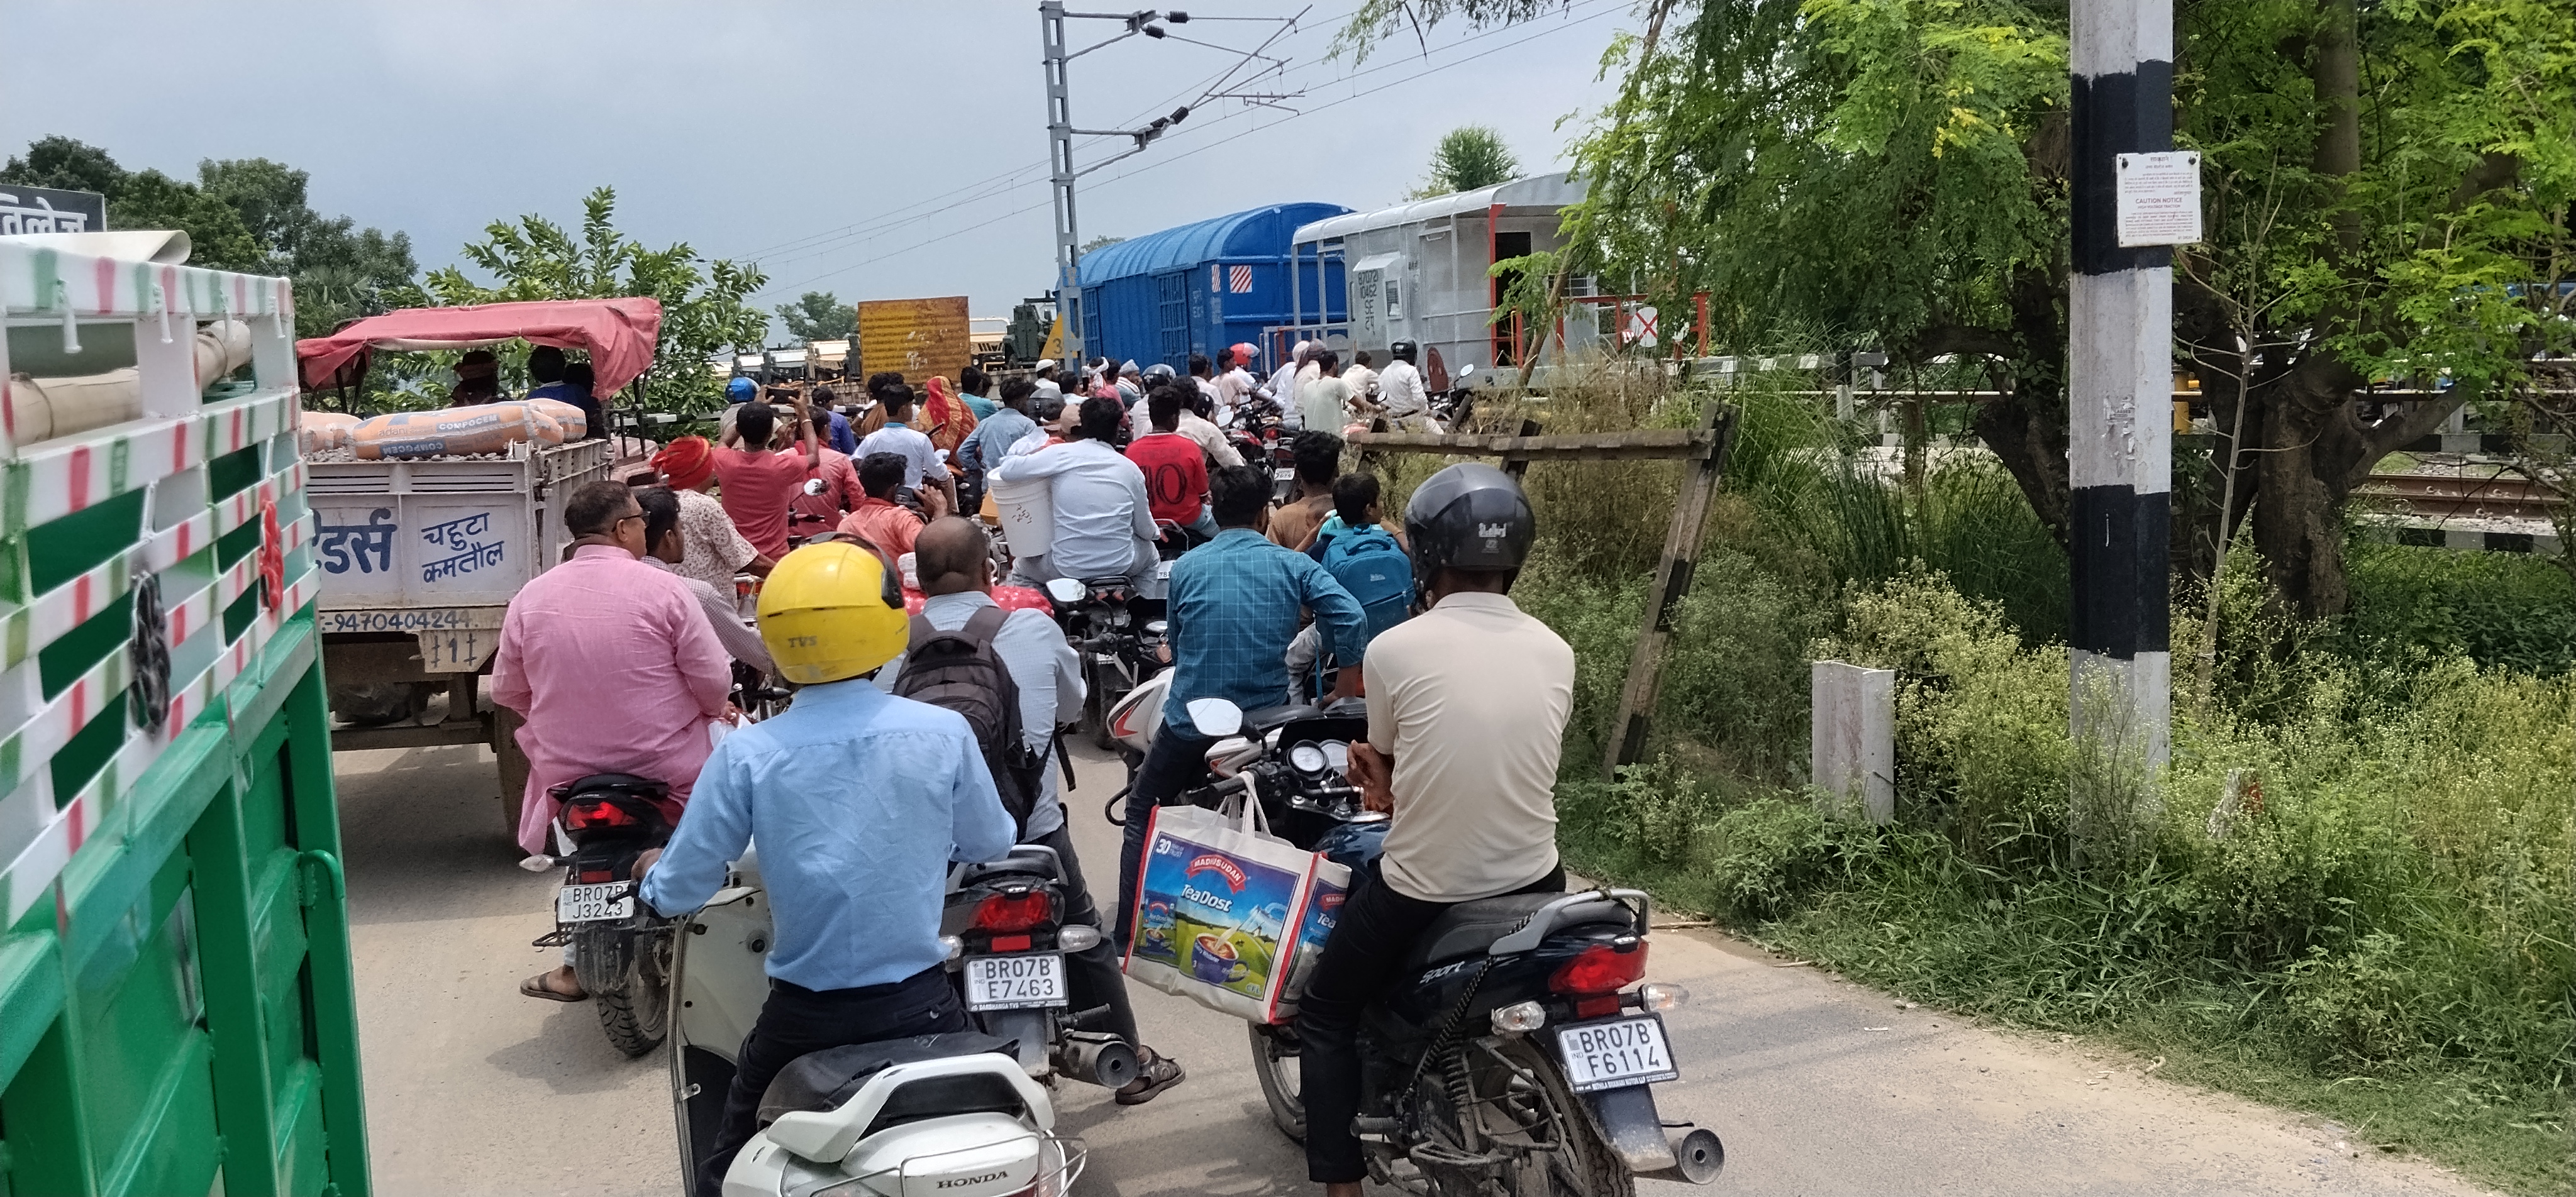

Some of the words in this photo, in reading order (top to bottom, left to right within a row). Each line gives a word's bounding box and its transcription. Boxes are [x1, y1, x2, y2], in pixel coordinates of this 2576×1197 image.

[1053, 338, 1063, 354] 3
[439, 414, 498, 430] COMPOCEM
[1140, 463, 1188, 507] 10
[313, 507, 398, 573] डर्स
[421, 512, 490, 551] चहुटा
[421, 541, 505, 583] कमतौल
[788, 635, 817, 648] TVS
[1156, 838, 1172, 855] 30
[1194, 858, 1241, 881] MADHUSUDAN
[573, 902, 623, 918] J3243
[1317, 912, 1336, 929] Tea
[985, 958, 1050, 979] BR07B
[988, 978, 1053, 998] E7463
[1579, 1022, 1650, 1053] BR07B
[1587, 1045, 1660, 1078] F6114
[936, 1171, 1009, 1189] HONDA
